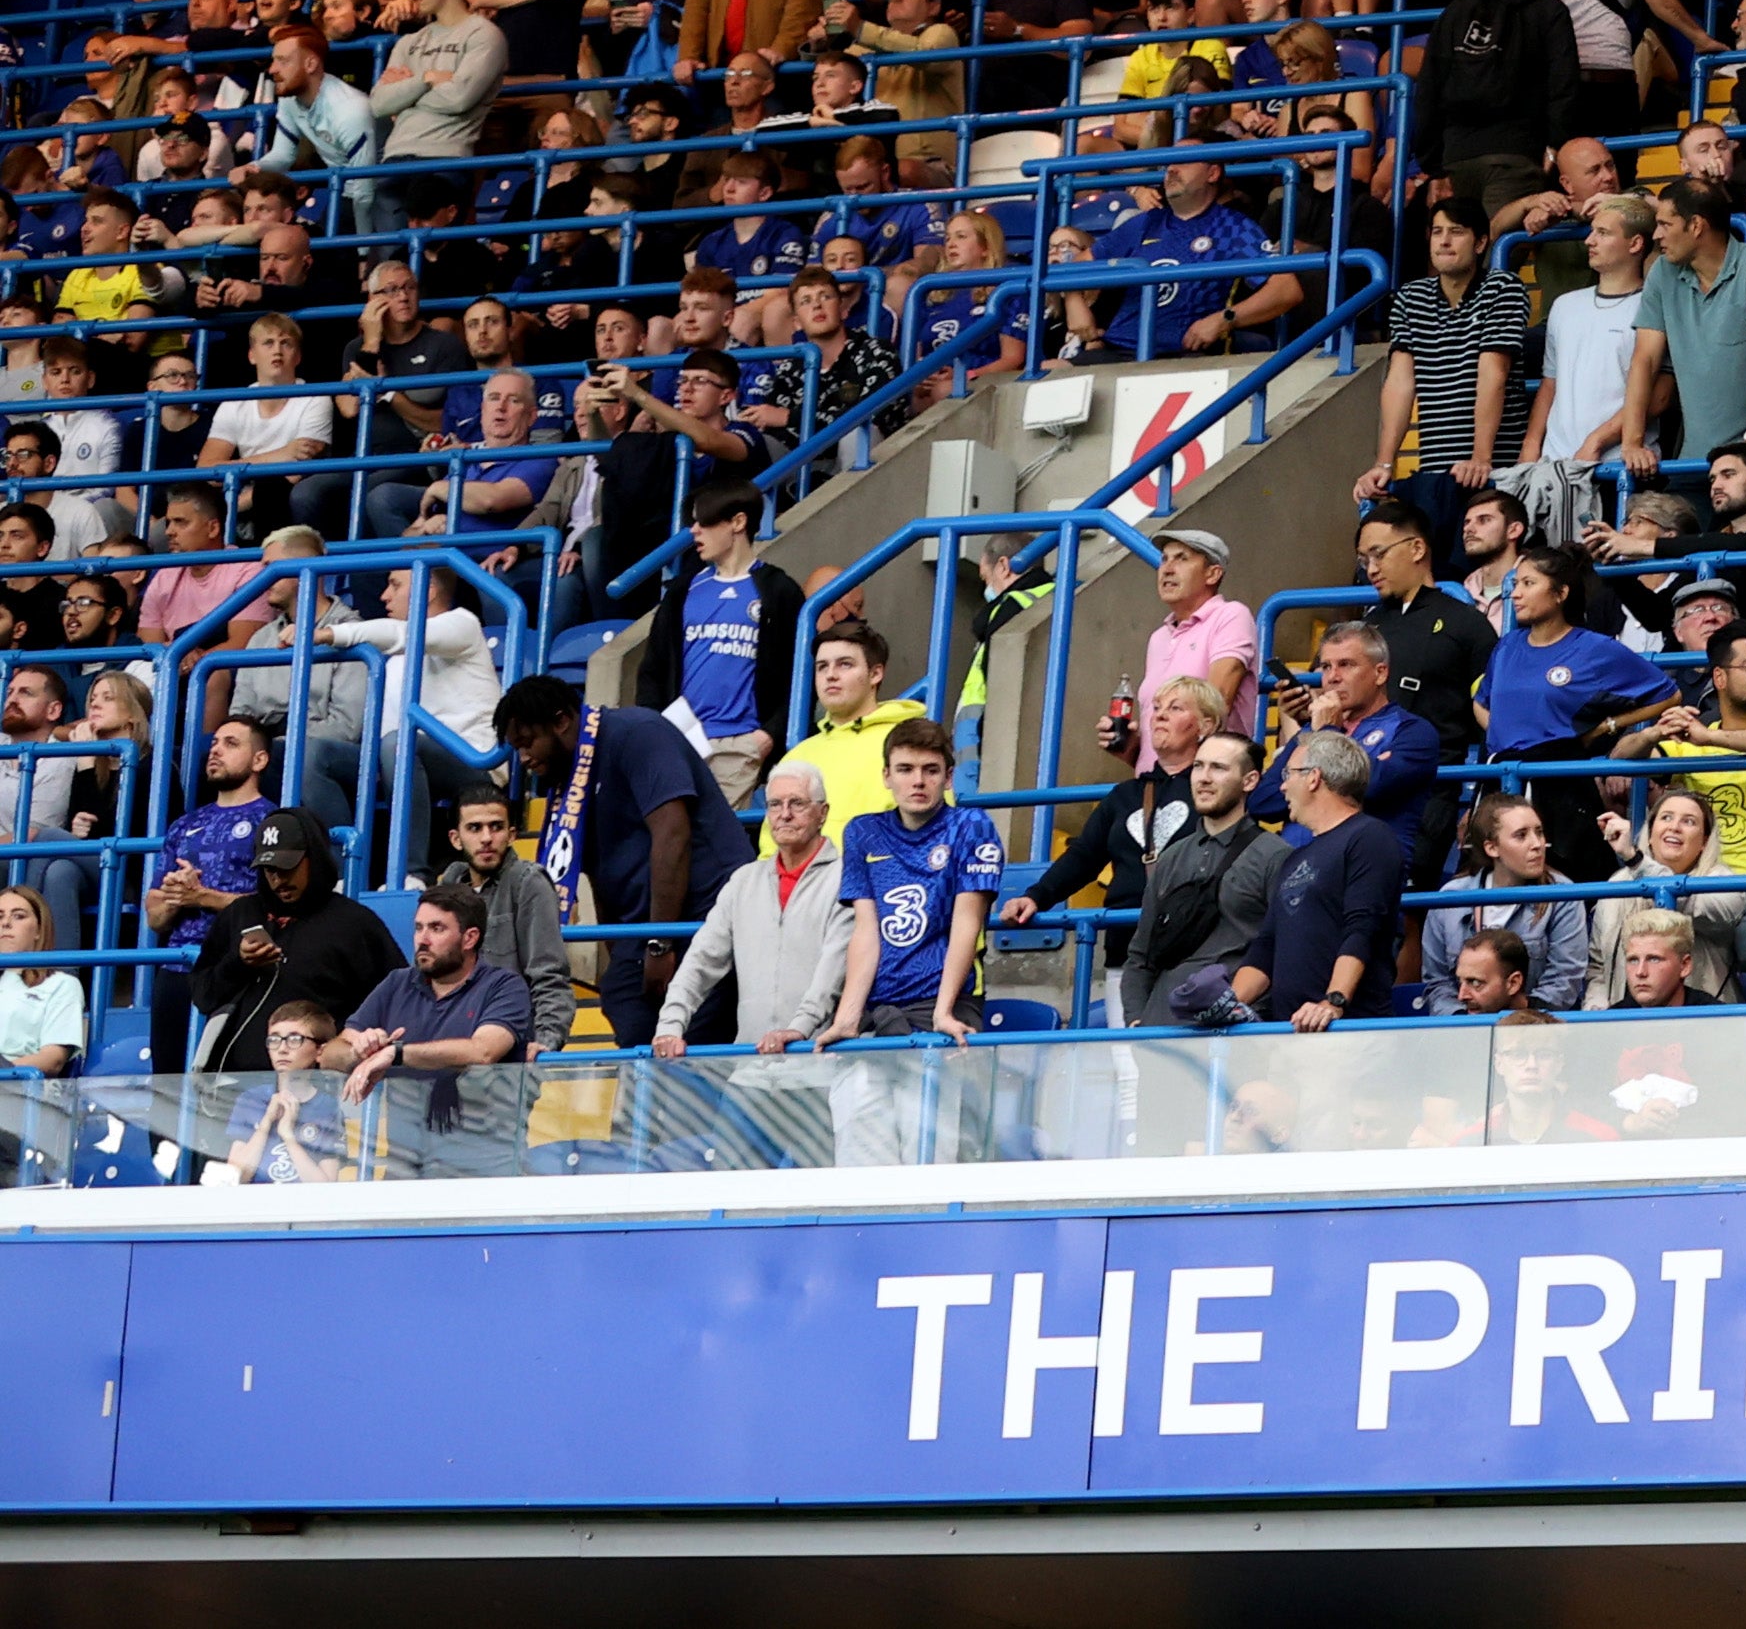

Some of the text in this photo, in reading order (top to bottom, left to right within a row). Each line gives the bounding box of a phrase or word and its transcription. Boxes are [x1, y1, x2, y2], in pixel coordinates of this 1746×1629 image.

[1130, 390, 1206, 509] 6
[559, 743, 595, 830] EUROPE
[876, 1266, 1274, 1441] THE
